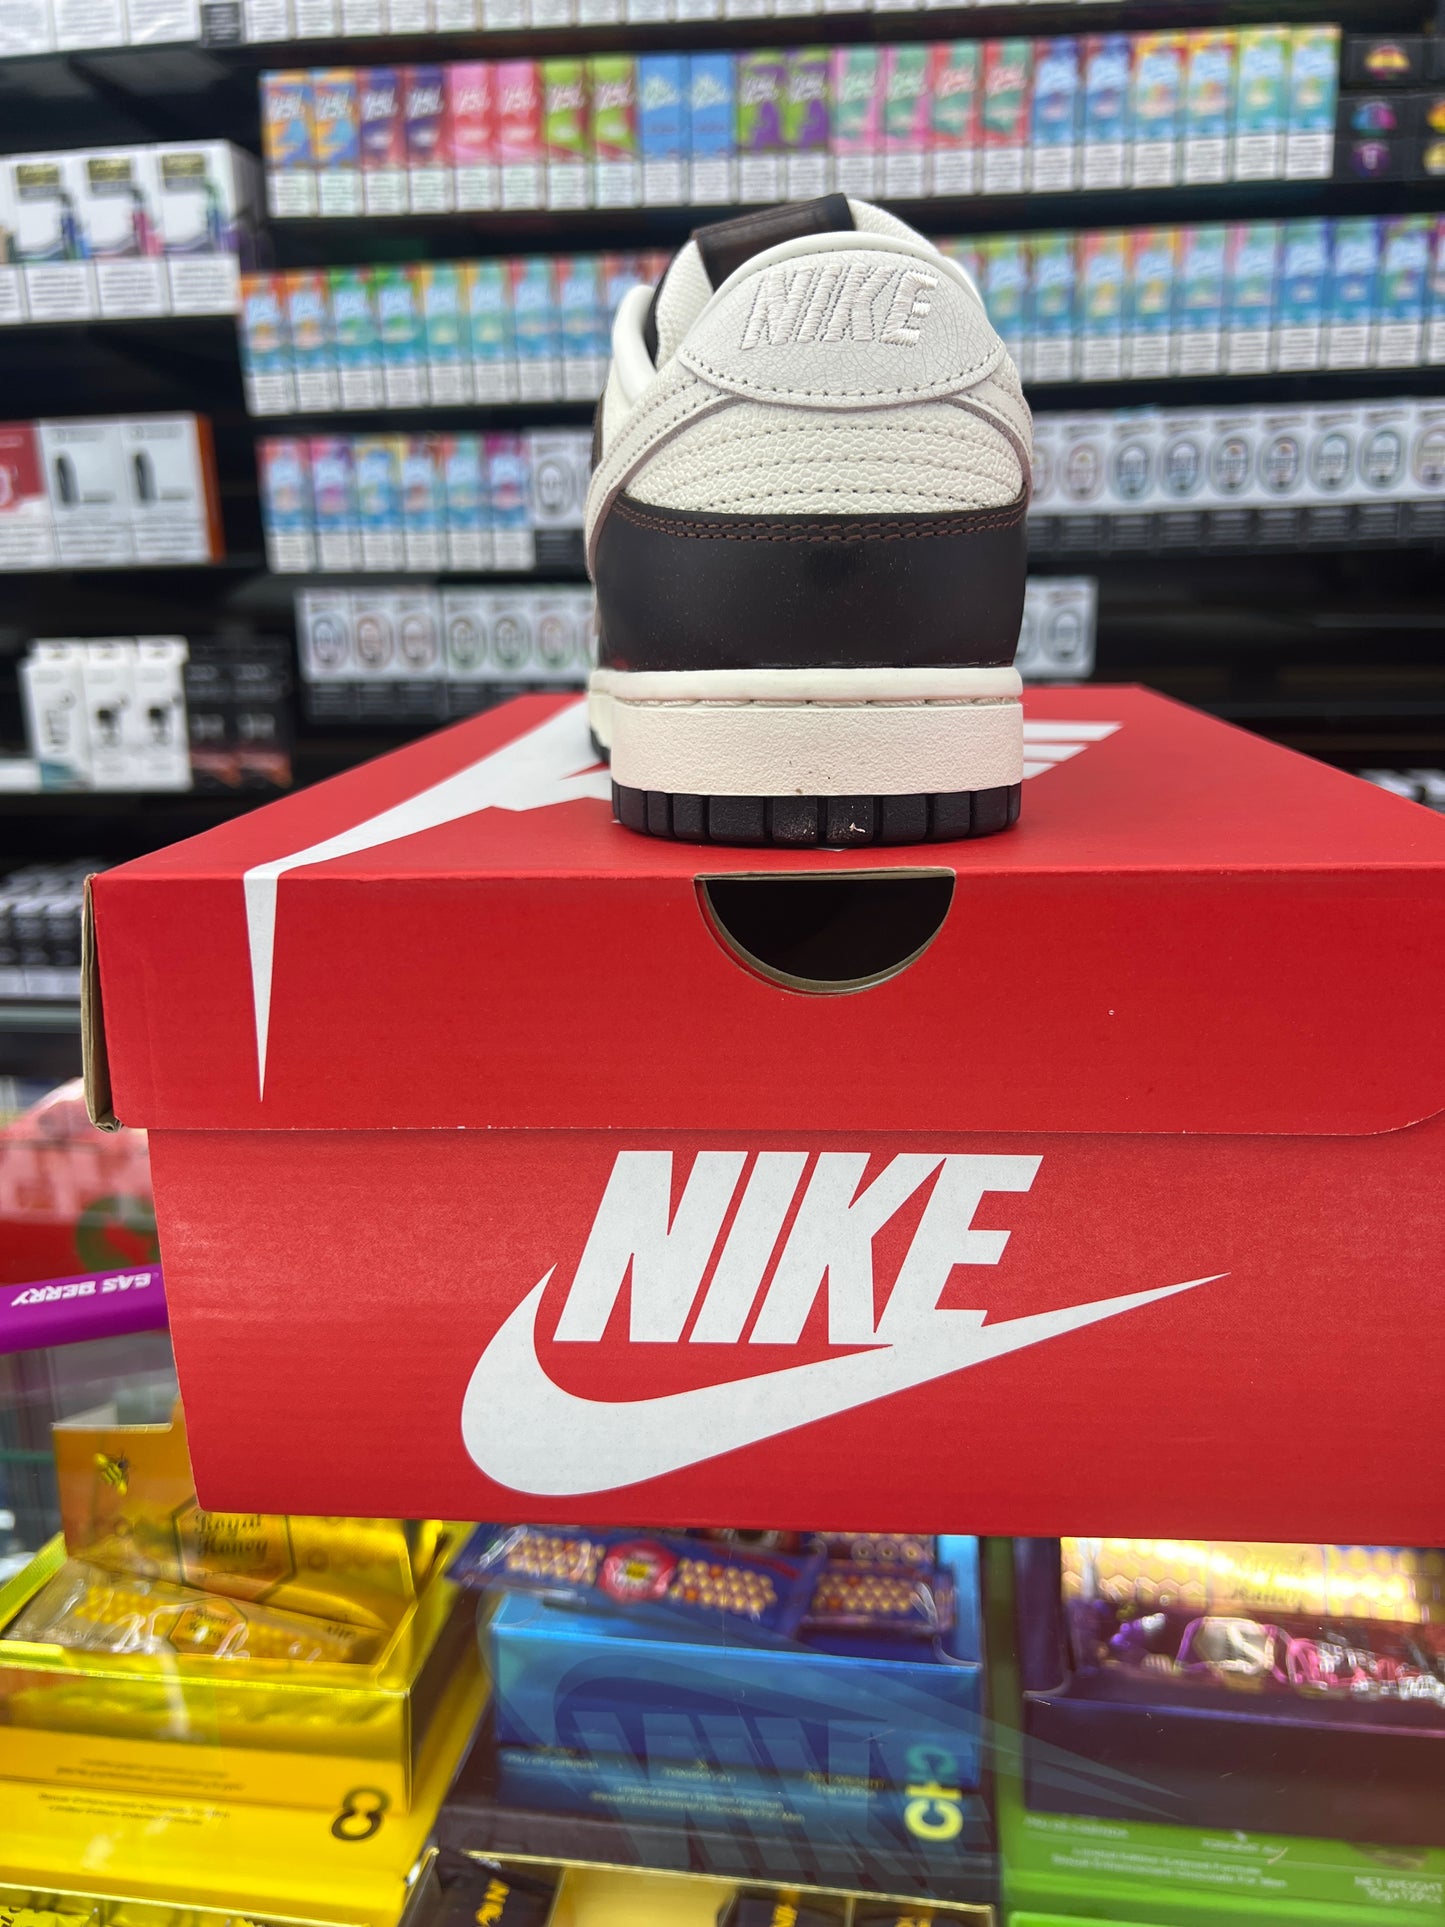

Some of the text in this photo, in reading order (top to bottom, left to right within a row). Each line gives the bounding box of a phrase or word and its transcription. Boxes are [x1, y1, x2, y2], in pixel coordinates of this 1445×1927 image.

[739, 263, 939, 352] NIKE
[553, 1150, 1044, 1346] NIKE
[11, 1280, 97, 1307] BERRY
